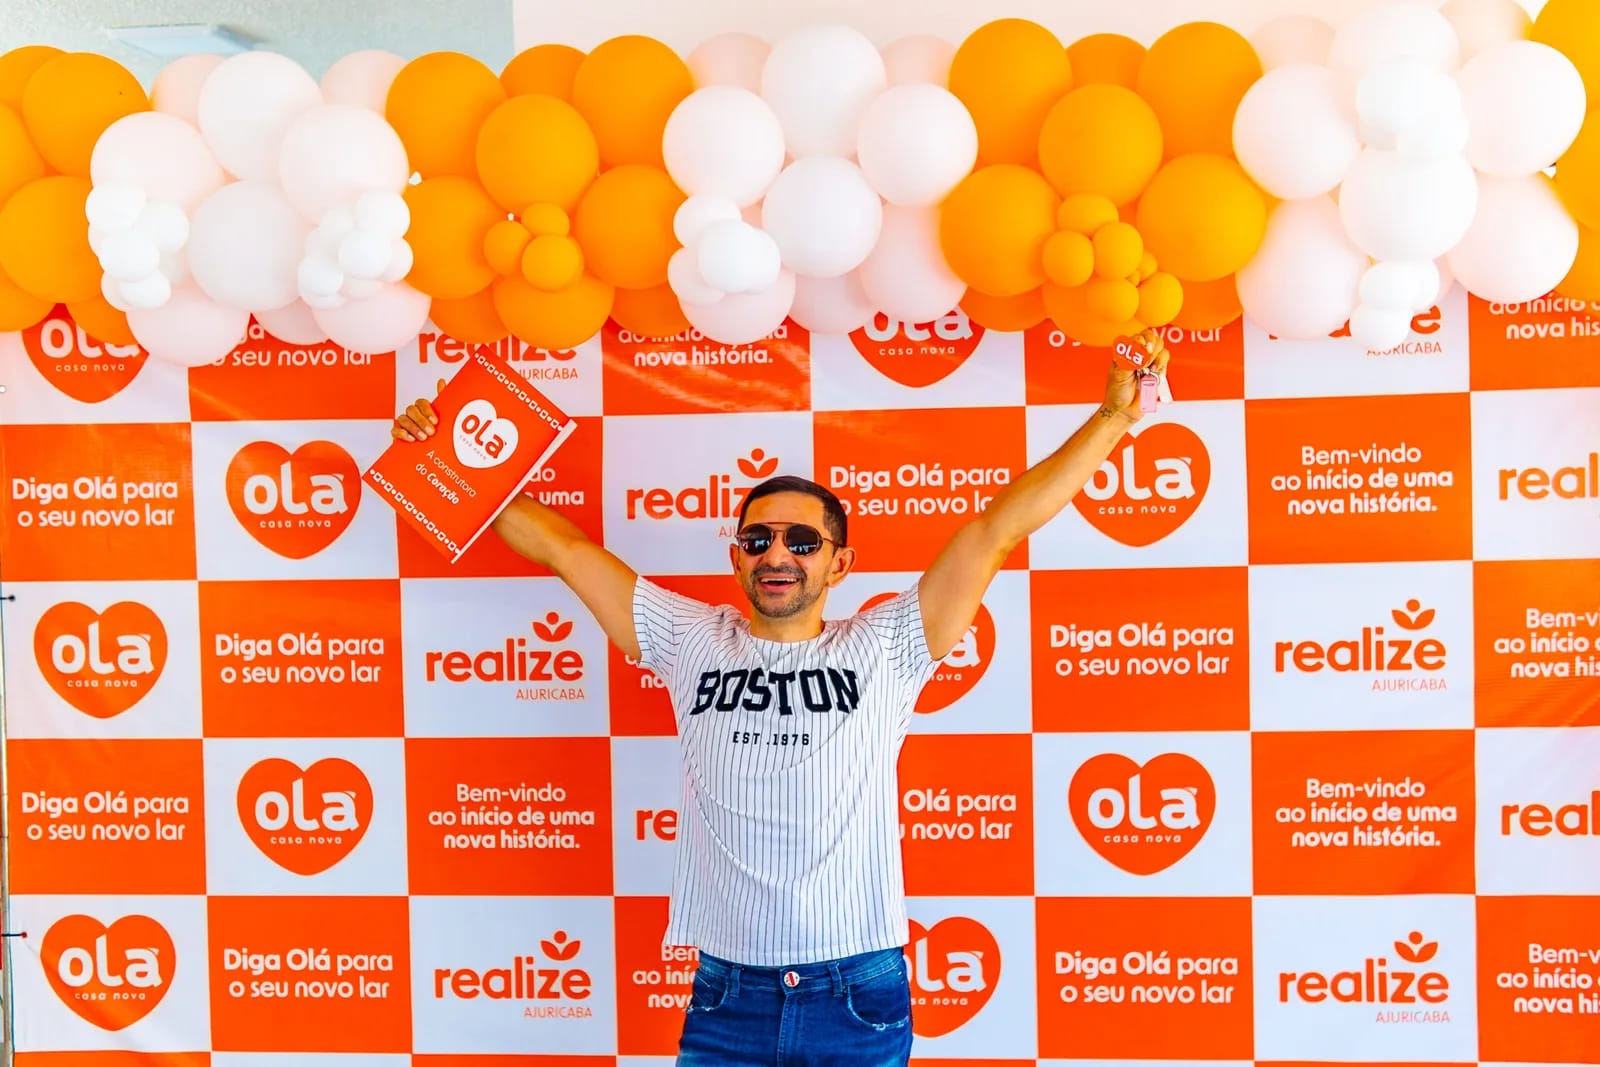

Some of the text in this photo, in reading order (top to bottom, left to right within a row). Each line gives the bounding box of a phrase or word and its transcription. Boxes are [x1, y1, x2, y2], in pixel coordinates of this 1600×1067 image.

[1506, 324, 1565, 339] nova
[232, 351, 271, 367] seu
[278, 350, 337, 367] novo
[634, 346, 773, 367] nova história.
[880, 346, 955, 356] casa nova
[56, 363, 125, 372] casa nova
[1302, 442, 1421, 465] Bem-vindo
[415, 463, 459, 505] do Coração
[426, 450, 476, 498] A construtora
[830, 463, 1010, 493] Diga Olá para
[1272, 468, 1453, 490] ao início de uma
[12, 476, 178, 504] Diga Olá para
[539, 491, 584, 506] uma
[626, 475, 757, 520] realiz
[858, 498, 898, 516] seu
[905, 497, 968, 516] novo
[1098, 505, 1176, 515] casa nova
[1288, 492, 1437, 514] nova história.
[18, 504, 174, 526] o seu novo lar
[260, 520, 292, 528] casa
[216, 633, 384, 661] Diga Olá para
[1050, 622, 1233, 652] Diga Olá para
[1494, 638, 1526, 654] ao
[1530, 632, 1590, 653] início
[426, 638, 583, 682] realize
[1276, 627, 1446, 672] realize
[221, 660, 380, 683] o seu novo lar
[1056, 651, 1229, 676] o seu novo lar
[1511, 662, 1570, 678] nova
[516, 688, 584, 700] AJURICABA
[690, 667, 859, 716] BOSTON
[1372, 678, 1446, 691] AJURICABA
[732, 732, 761, 745] EST
[457, 783, 566, 802] Bem-vindo
[1307, 777, 1425, 798] Bem-vindo
[22, 791, 188, 818] Diga Olá para
[903, 788, 1017, 817] Olá para
[1276, 802, 1456, 822] ao início de uma
[428, 806, 594, 825] ao início de uma
[27, 818, 184, 840] o seu novo lar
[444, 829, 580, 848] nova história.
[911, 822, 974, 840] novo
[980, 816, 1013, 840] lar
[1292, 826, 1440, 846] nova história.
[224, 948, 392, 976] Diga Olá para
[1056, 951, 1238, 980] Diga Olá para
[229, 976, 389, 998] o seu novo lar
[435, 956, 591, 1000] realize
[633, 970, 661, 985] ao
[1280, 958, 1448, 1003] realize
[1496, 972, 1529, 988] ao
[1533, 967, 1593, 988] início
[75, 992, 145, 1000] casa nova
[648, 993, 692, 1008] nov
[933, 998, 968, 1006] nova
[1060, 980, 1234, 1003] o seu novo lar
[524, 1006, 592, 1018] AJURICABA
[1514, 997, 1573, 1014] nova
[1376, 1011, 1450, 1023] AJURICABA
